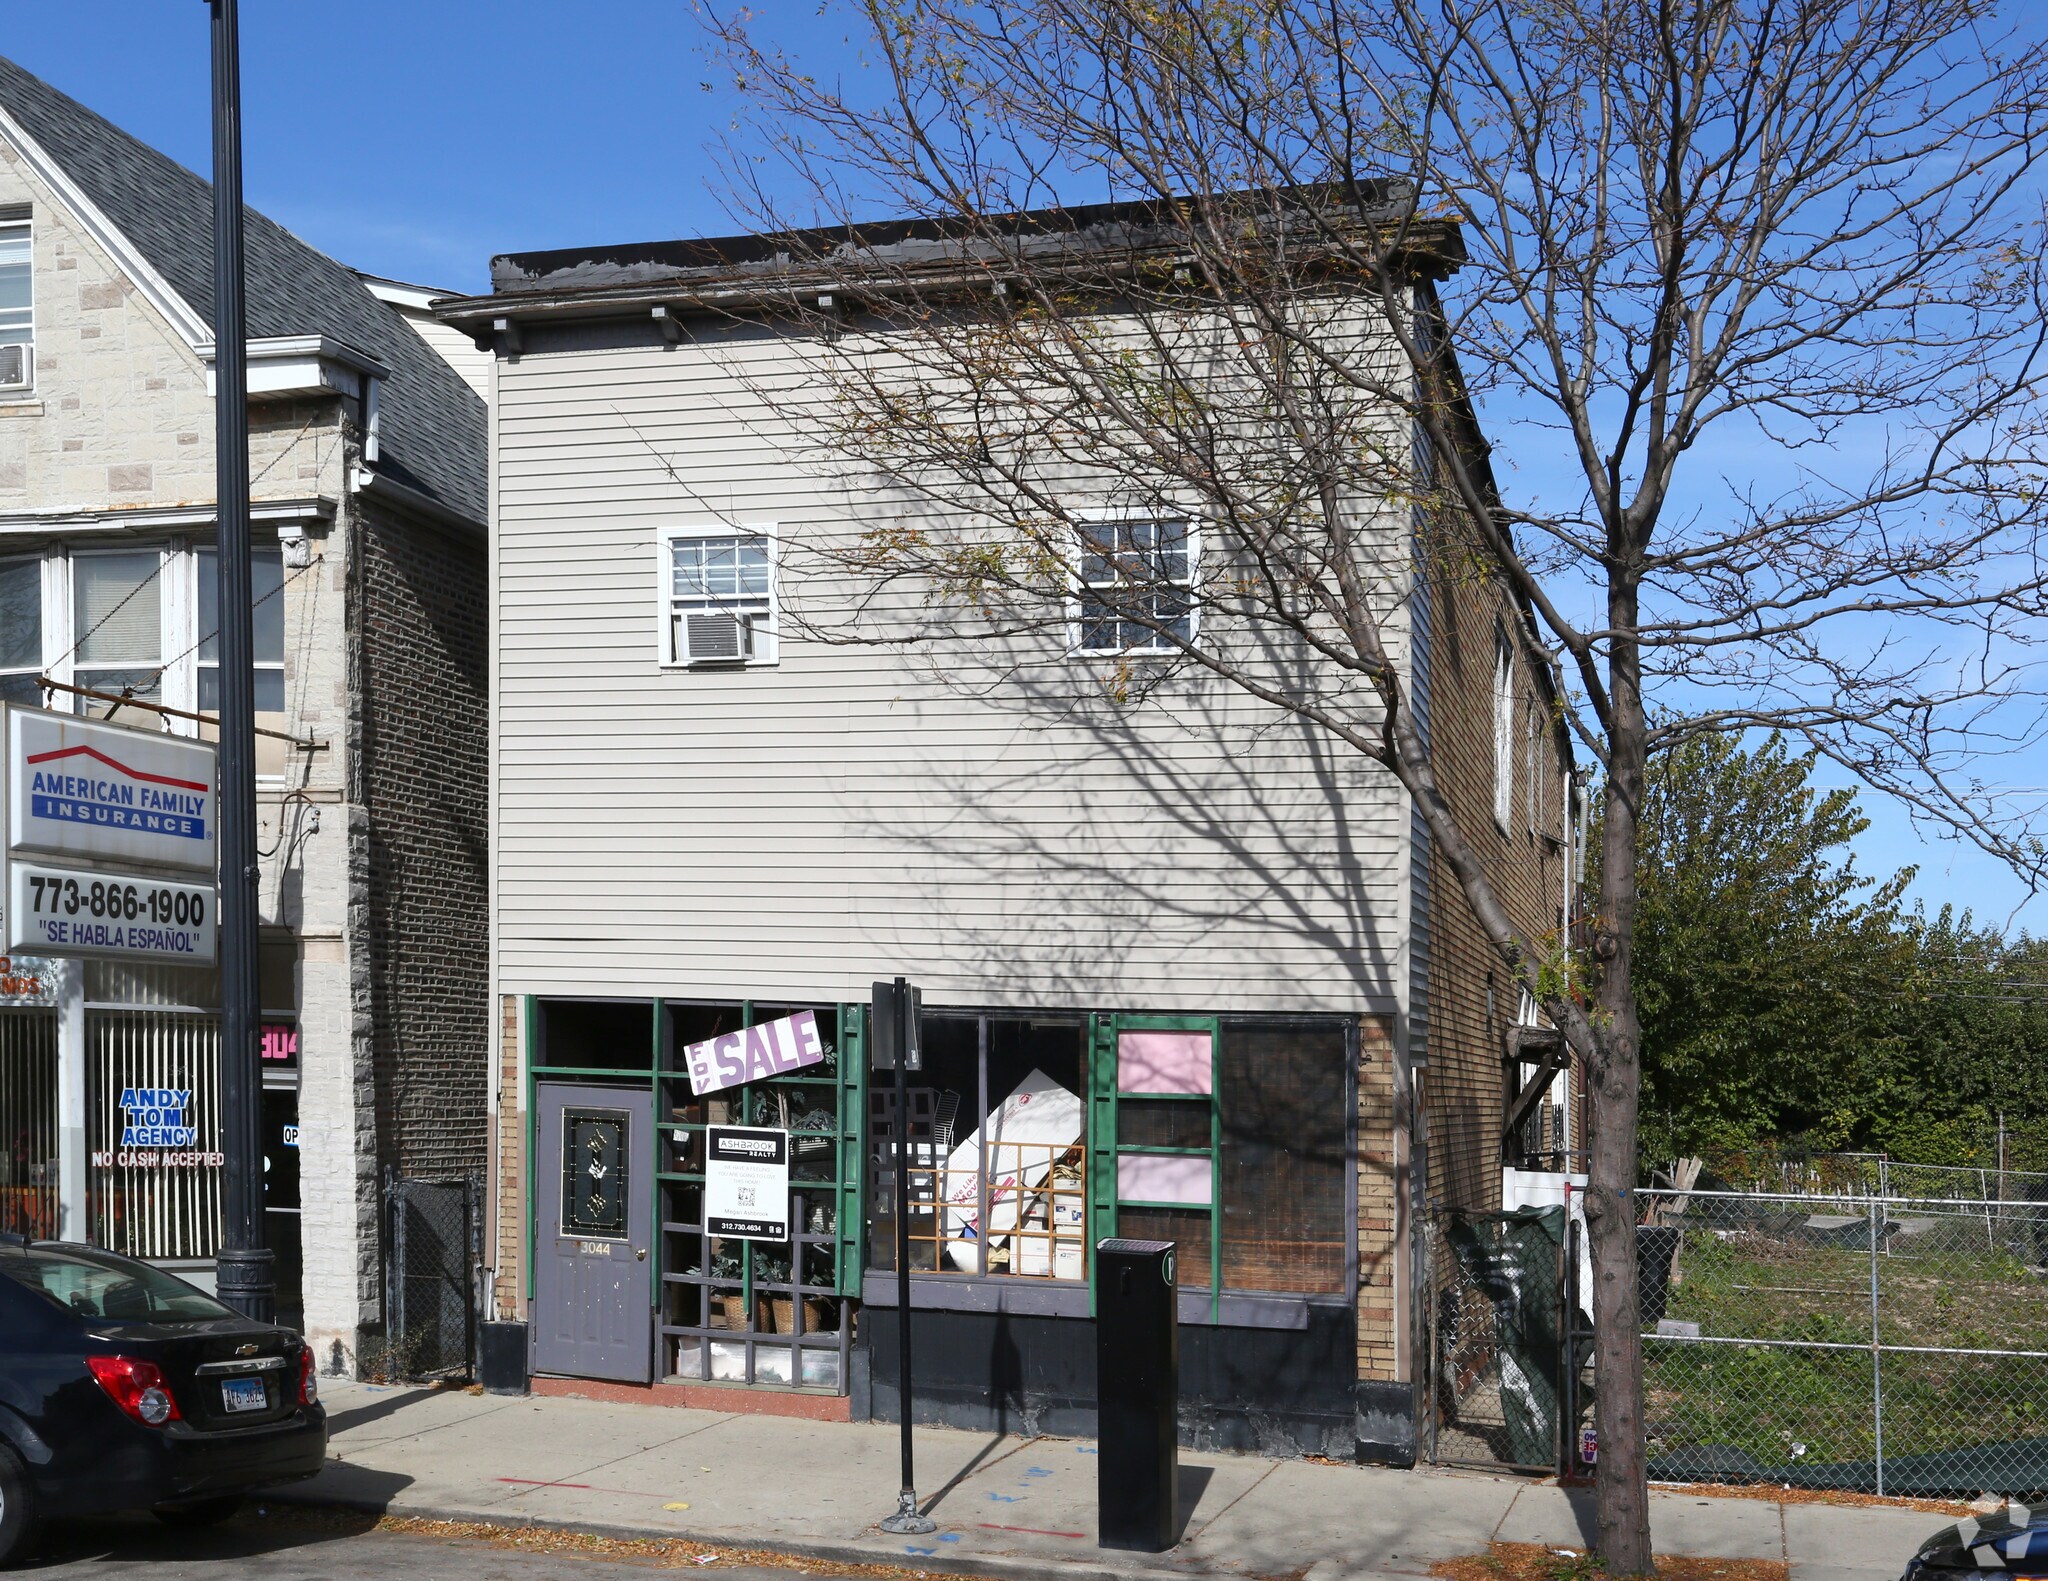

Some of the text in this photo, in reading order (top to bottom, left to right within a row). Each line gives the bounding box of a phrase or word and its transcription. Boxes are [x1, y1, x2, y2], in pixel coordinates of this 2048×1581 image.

[32, 771, 205, 816] AMERICAN FAMILY
[47, 801, 192, 834] INSURANCE
[30, 876, 204, 927] 773-866-1900
[73, 922, 124, 947] HABLA
[713, 1010, 823, 1088] SALE
[119, 1088, 191, 1108] ANDY
[128, 1107, 182, 1127] TOM
[121, 1127, 197, 1147] AGENCY
[720, 1139, 774, 1151] ASHBROOK
[92, 1151, 225, 1167] NO CASH ACCEPTED
[748, 1150, 777, 1158] REALTY
[580, 1241, 610, 1256] 3044
